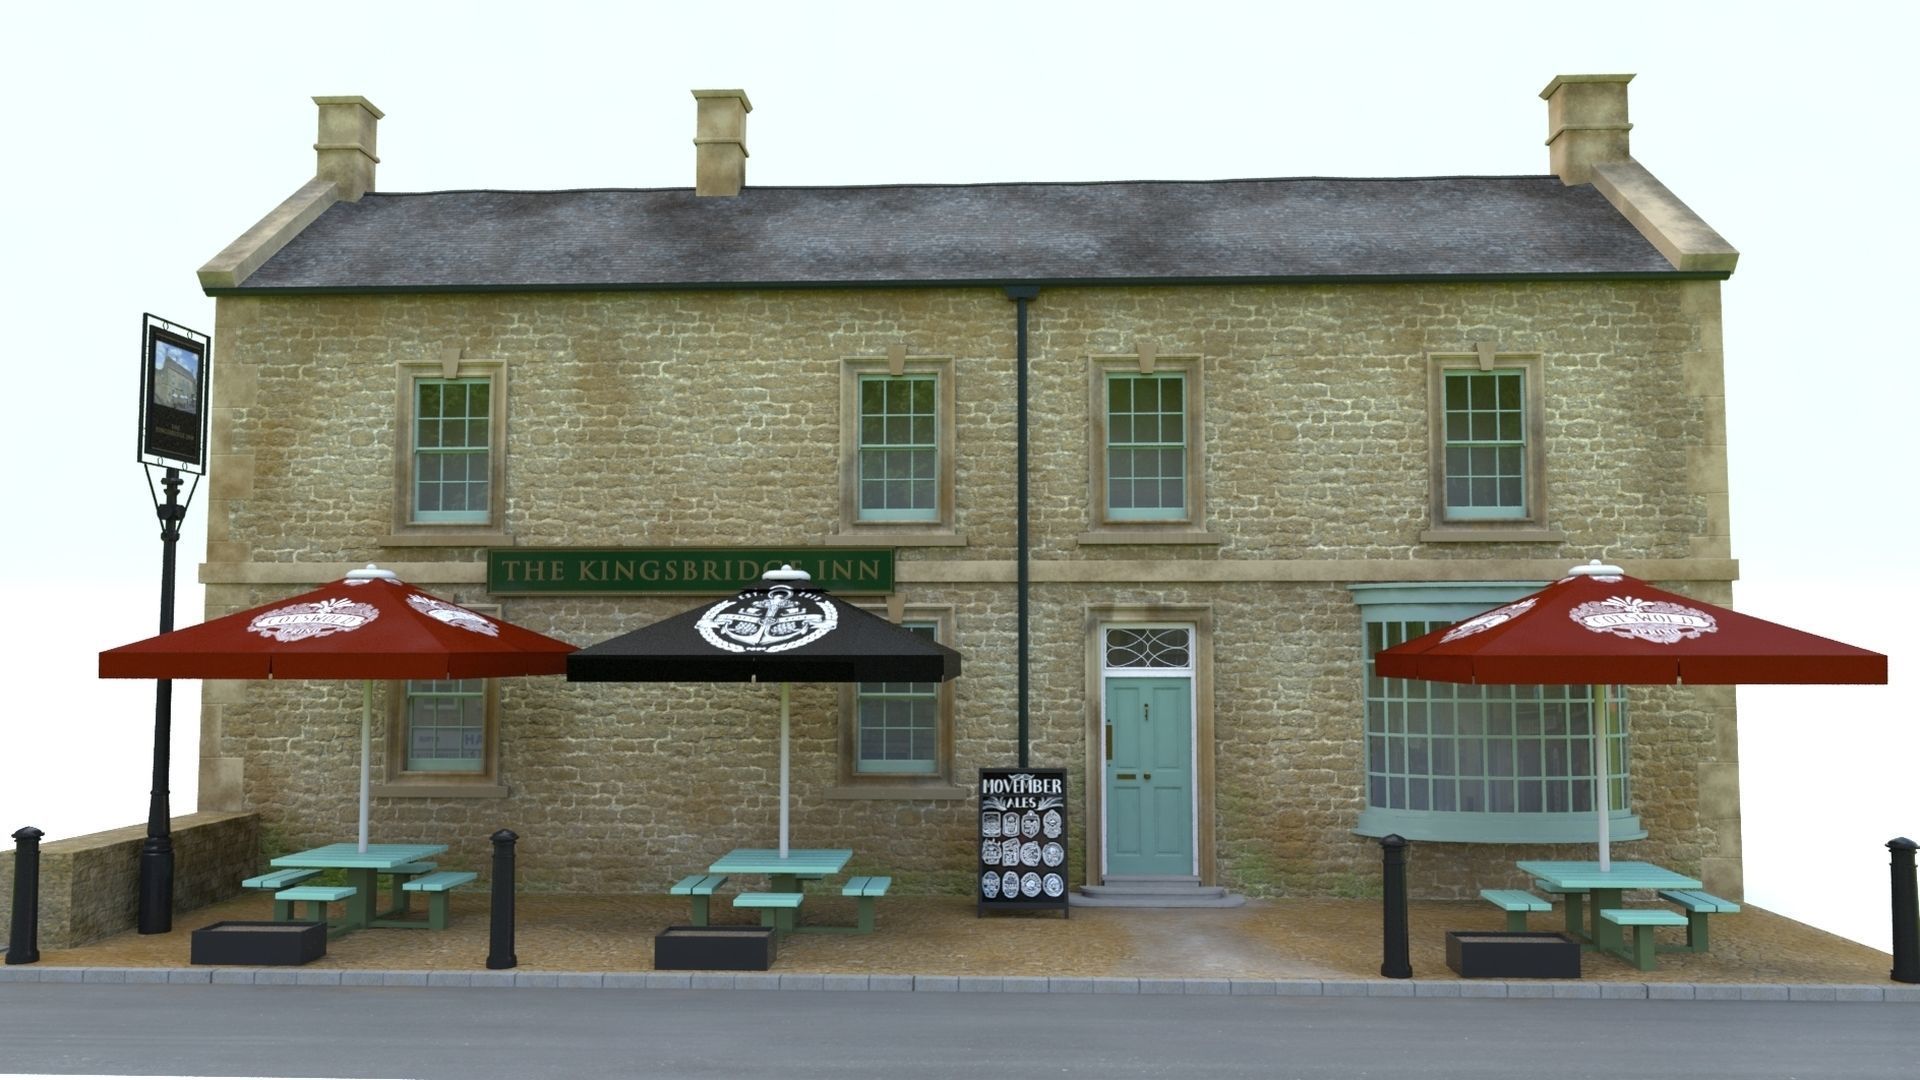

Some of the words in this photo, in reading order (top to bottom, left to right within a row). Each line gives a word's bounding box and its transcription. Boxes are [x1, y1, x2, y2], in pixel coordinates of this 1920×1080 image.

[501, 559, 565, 582] THE
[817, 559, 881, 581] INN
[982, 778, 1063, 794] MOVEMBER
[1006, 796, 1037, 809] ALES
